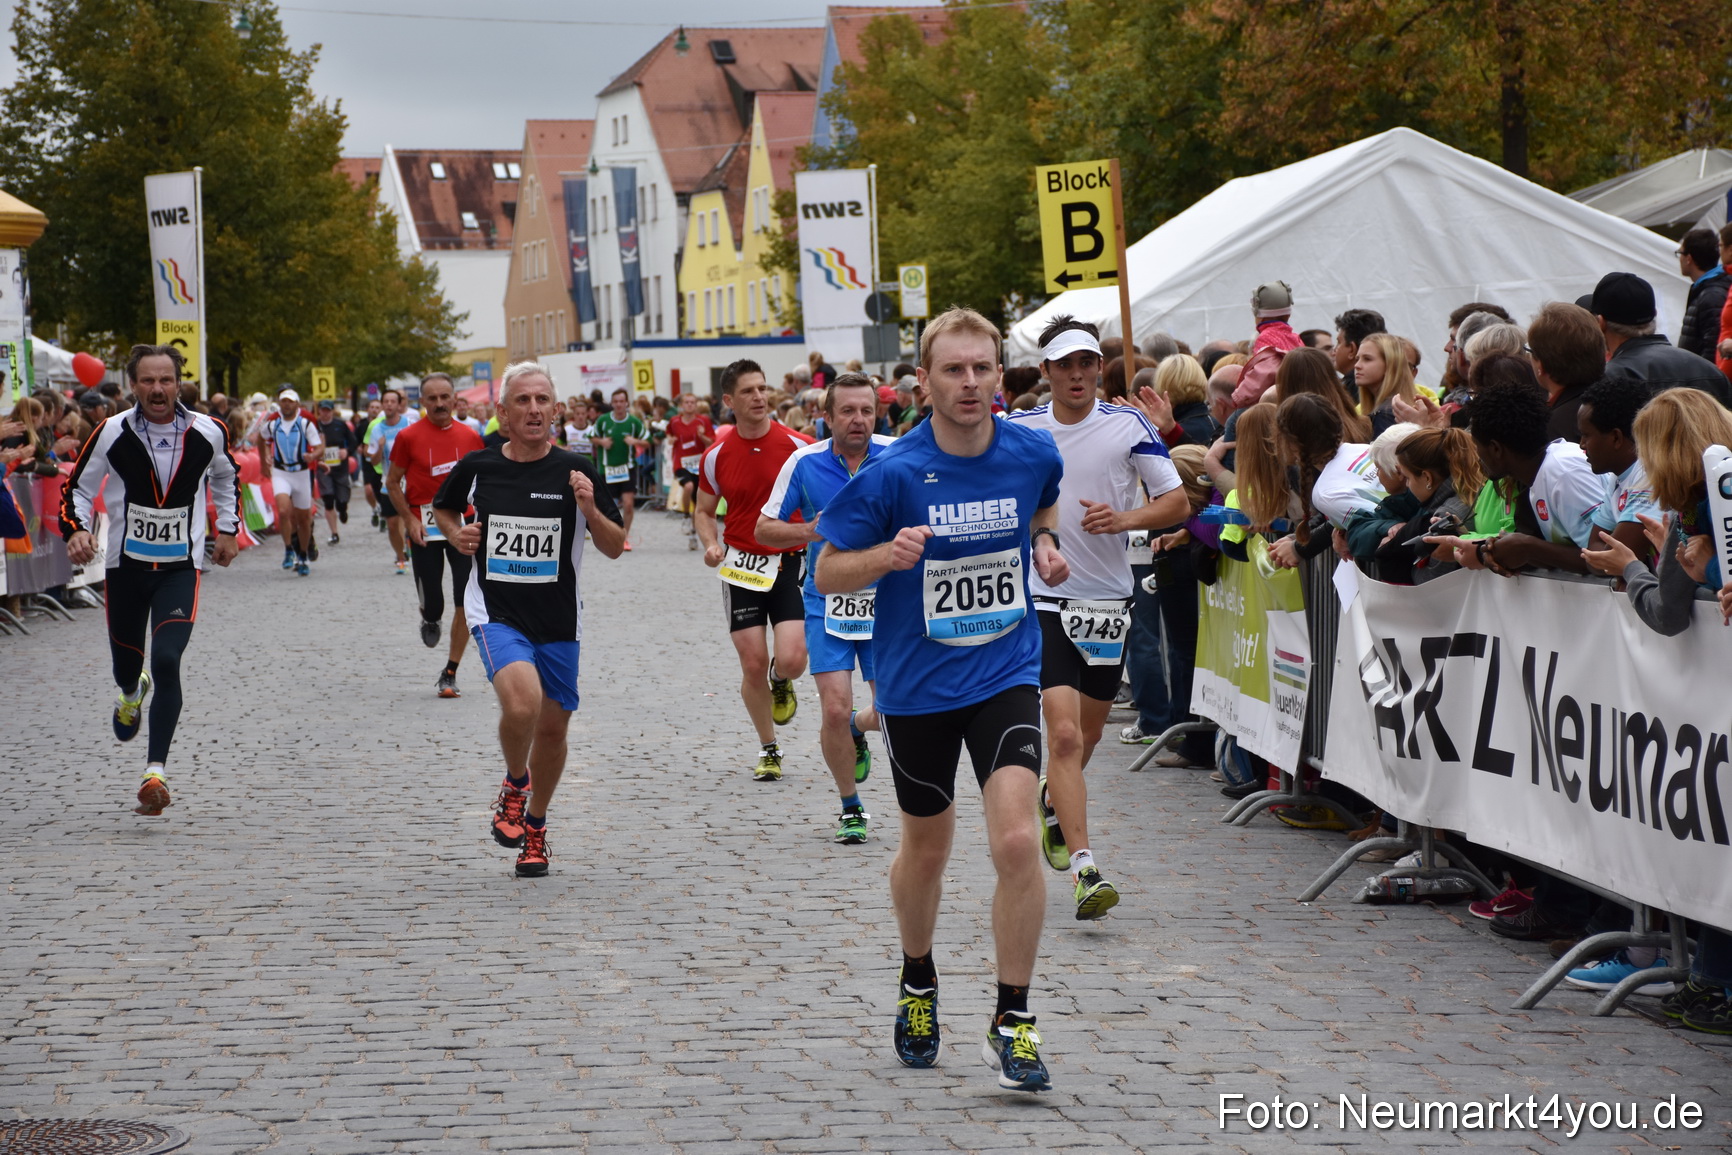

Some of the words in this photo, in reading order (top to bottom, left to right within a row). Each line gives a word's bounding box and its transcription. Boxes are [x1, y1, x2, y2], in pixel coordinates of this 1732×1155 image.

[1047, 166, 1112, 193] Block
[1061, 201, 1105, 263] B
[161, 322, 194, 334] Block
[638, 368, 650, 385] D
[318, 378, 330, 394] D
[130, 508, 148, 518] PARTL
[928, 498, 1018, 525] HUBER
[133, 518, 181, 542] 3041
[490, 521, 513, 530] PARTL
[515, 523, 549, 531] Neumarkt
[949, 519, 1016, 534] TECHNOLOGY
[494, 532, 554, 558] 2404
[949, 535, 969, 543] WASTE
[970, 533, 991, 542] WATER
[991, 530, 1015, 539] Solutions
[508, 563, 537, 574] Alfons
[734, 551, 770, 575] 302
[927, 567, 959, 578] PARTL
[960, 561, 1007, 573] Neumarkt
[728, 571, 764, 587] Alexander
[934, 571, 1015, 614] 2056
[839, 622, 871, 632] Michael
[951, 618, 1003, 635] Thomas
[1069, 615, 1125, 640] 2143
